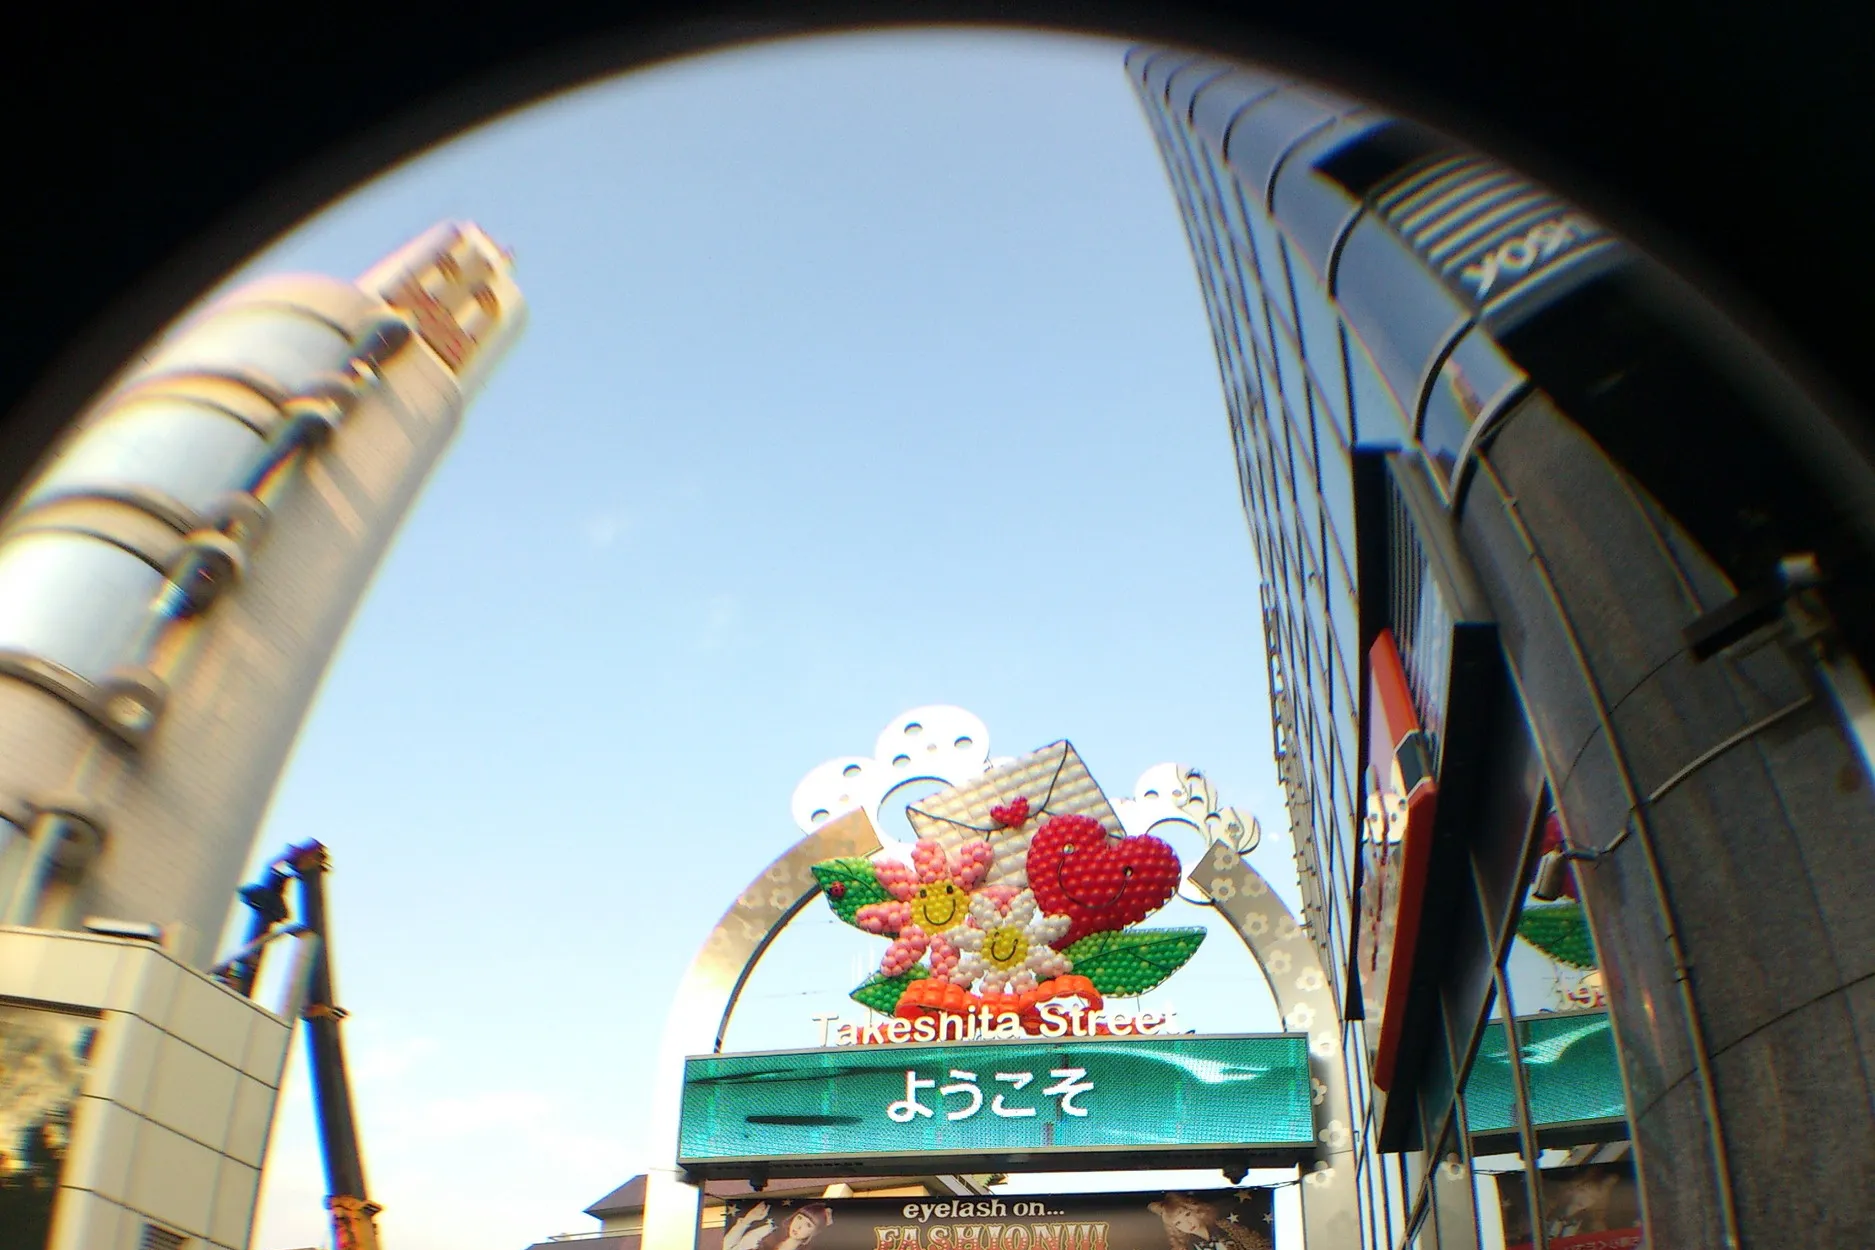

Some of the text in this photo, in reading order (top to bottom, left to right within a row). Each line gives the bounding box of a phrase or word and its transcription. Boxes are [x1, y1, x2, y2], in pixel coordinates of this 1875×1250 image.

[812, 997, 1179, 1046] Takeshita Street
[885, 1067, 1094, 1122] ようこそ
[902, 1199, 1065, 1223] eyelash on...
